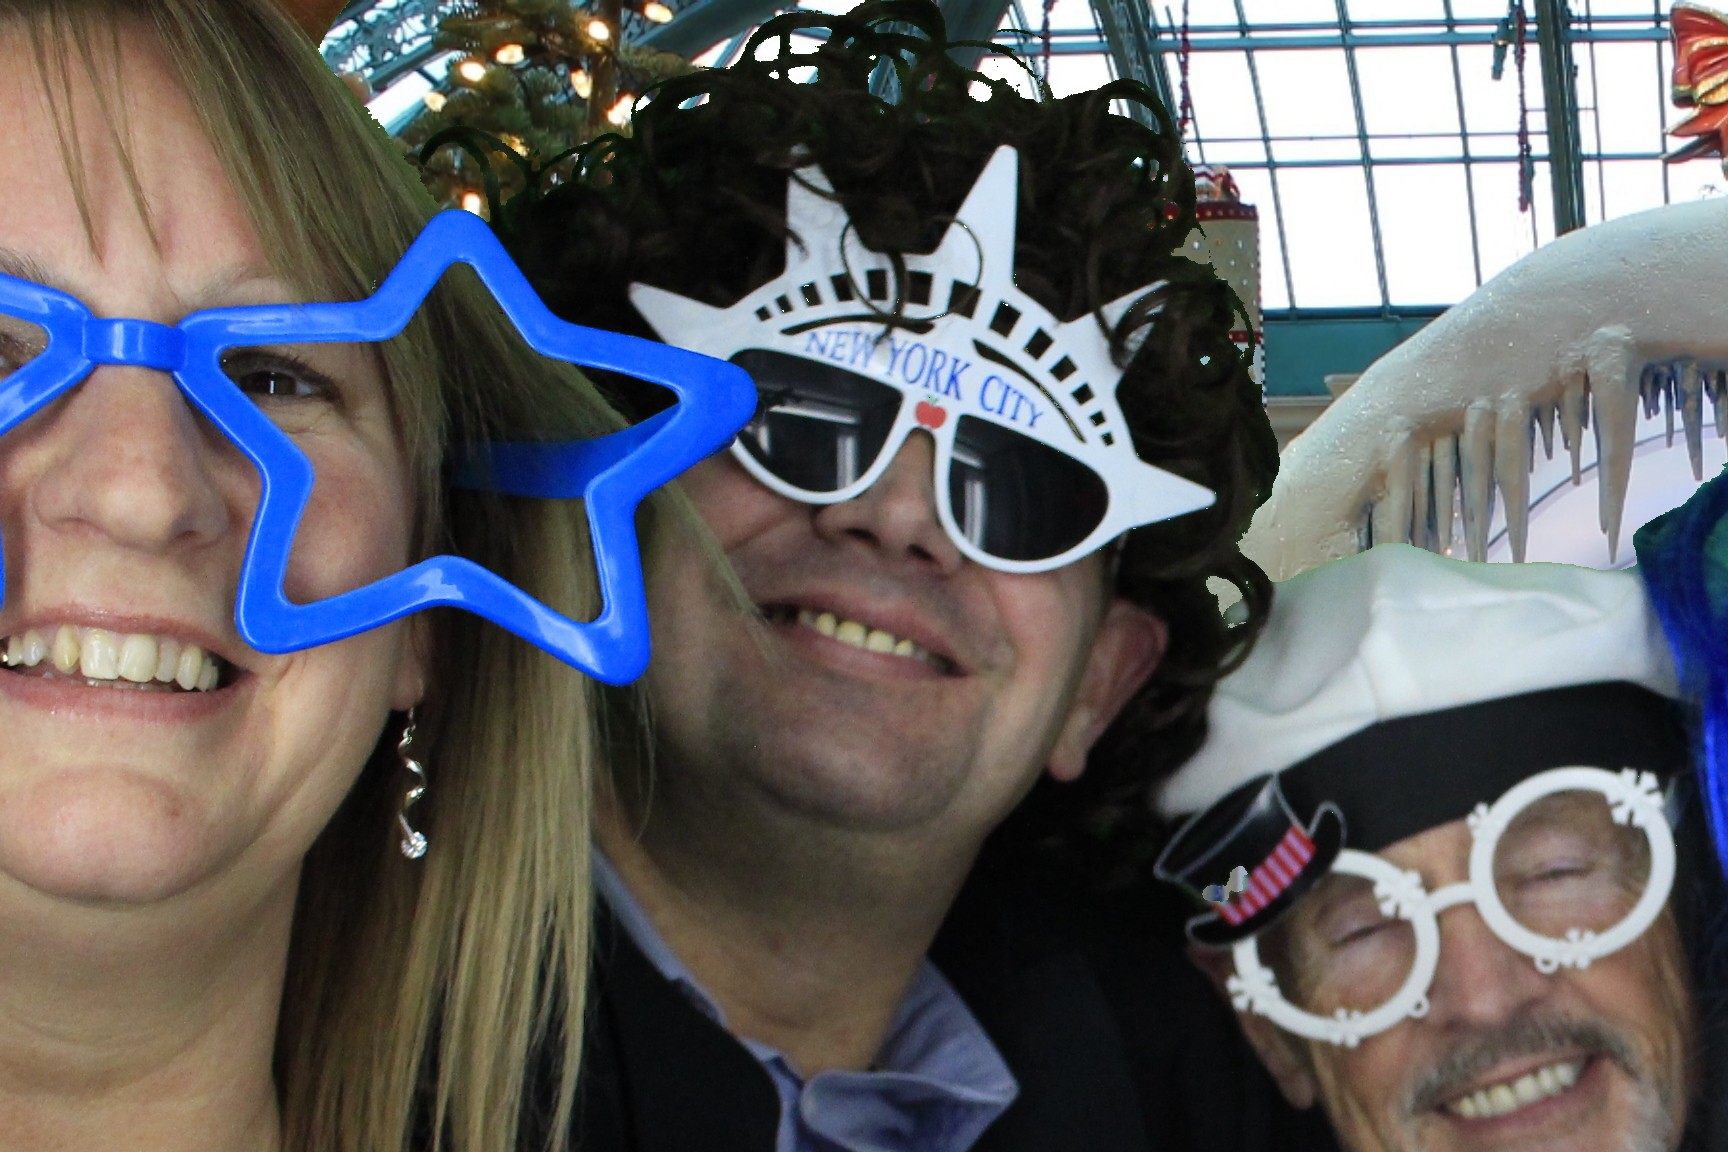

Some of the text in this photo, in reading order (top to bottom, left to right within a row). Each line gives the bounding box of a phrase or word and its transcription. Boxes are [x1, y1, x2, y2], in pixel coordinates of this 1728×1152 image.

[804, 330, 1044, 428] NEW YORK CITY
